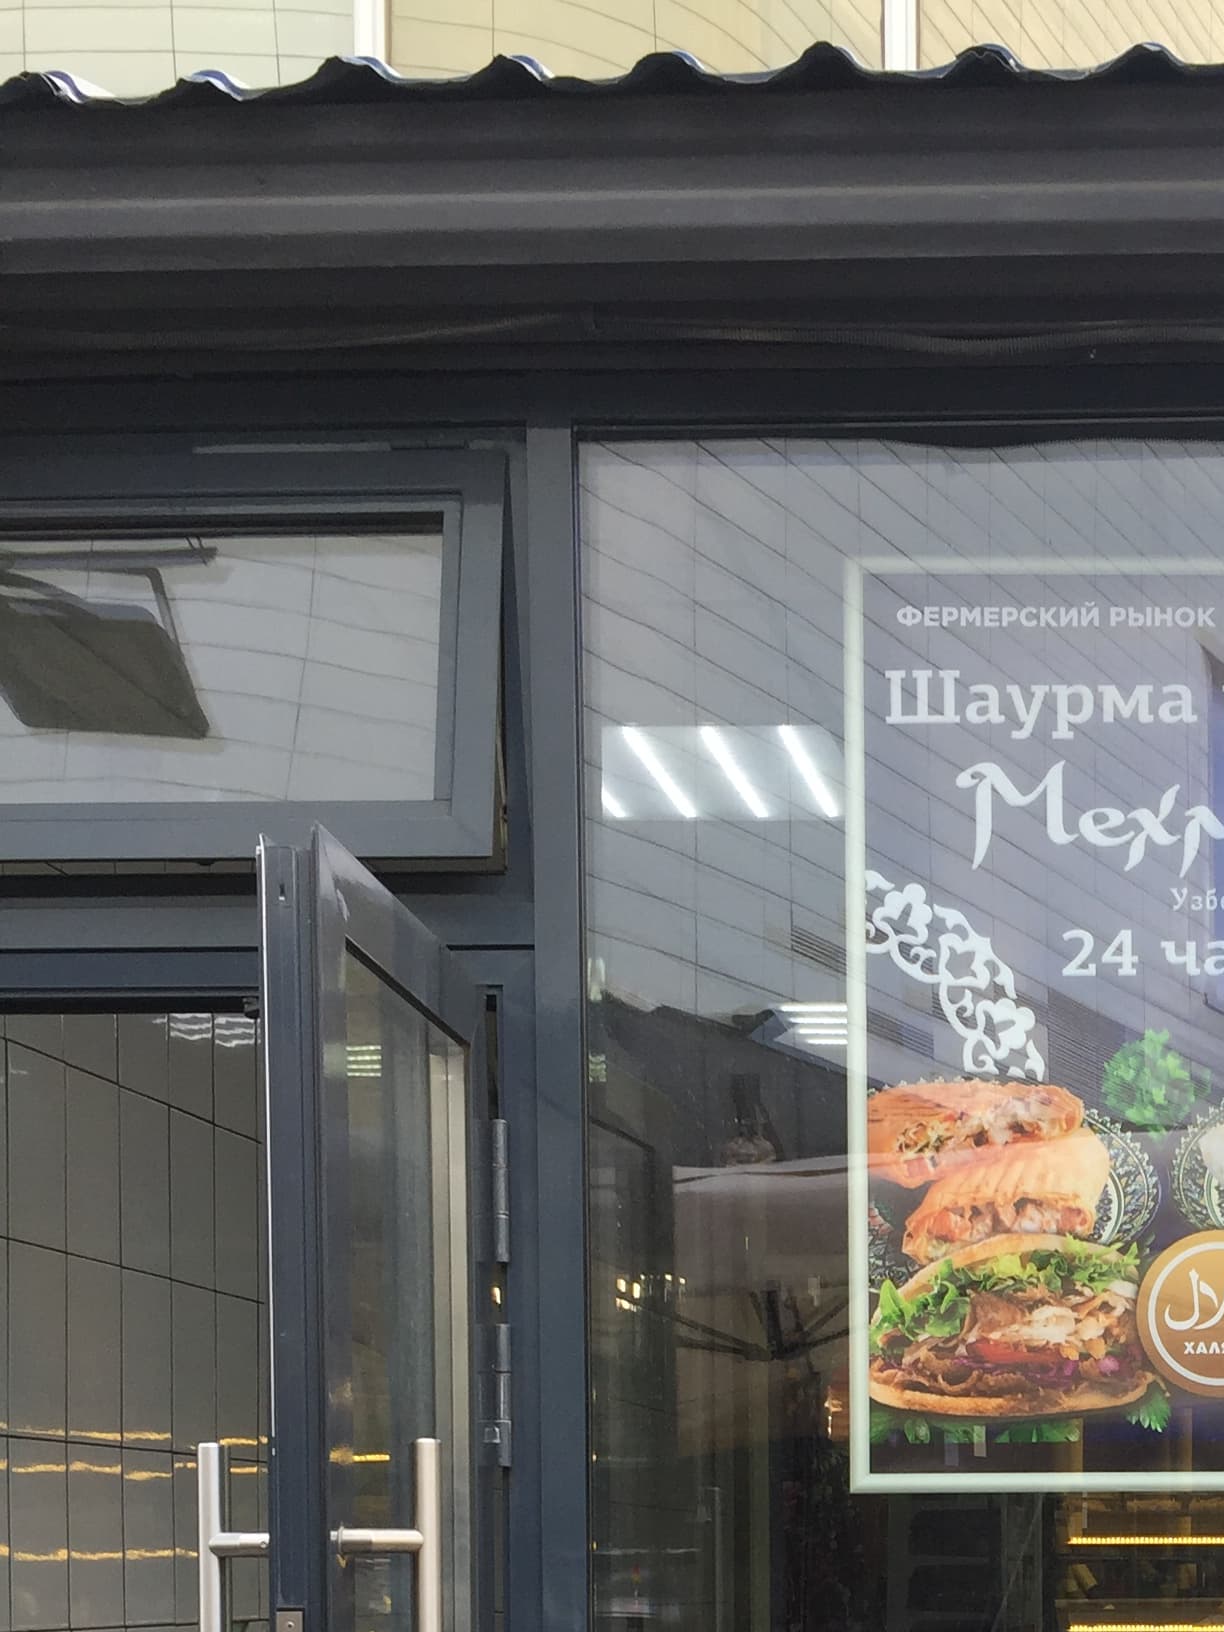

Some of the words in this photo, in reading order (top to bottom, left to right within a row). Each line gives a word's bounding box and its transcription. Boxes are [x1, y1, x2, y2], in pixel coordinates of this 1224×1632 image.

[896, 600, 1100, 629] ФЕРМЕРСКИЙ
[1109, 605, 1216, 629] РЫНОК
[884, 669, 1198, 739] Шаурма
[1061, 929, 1138, 977] 24
